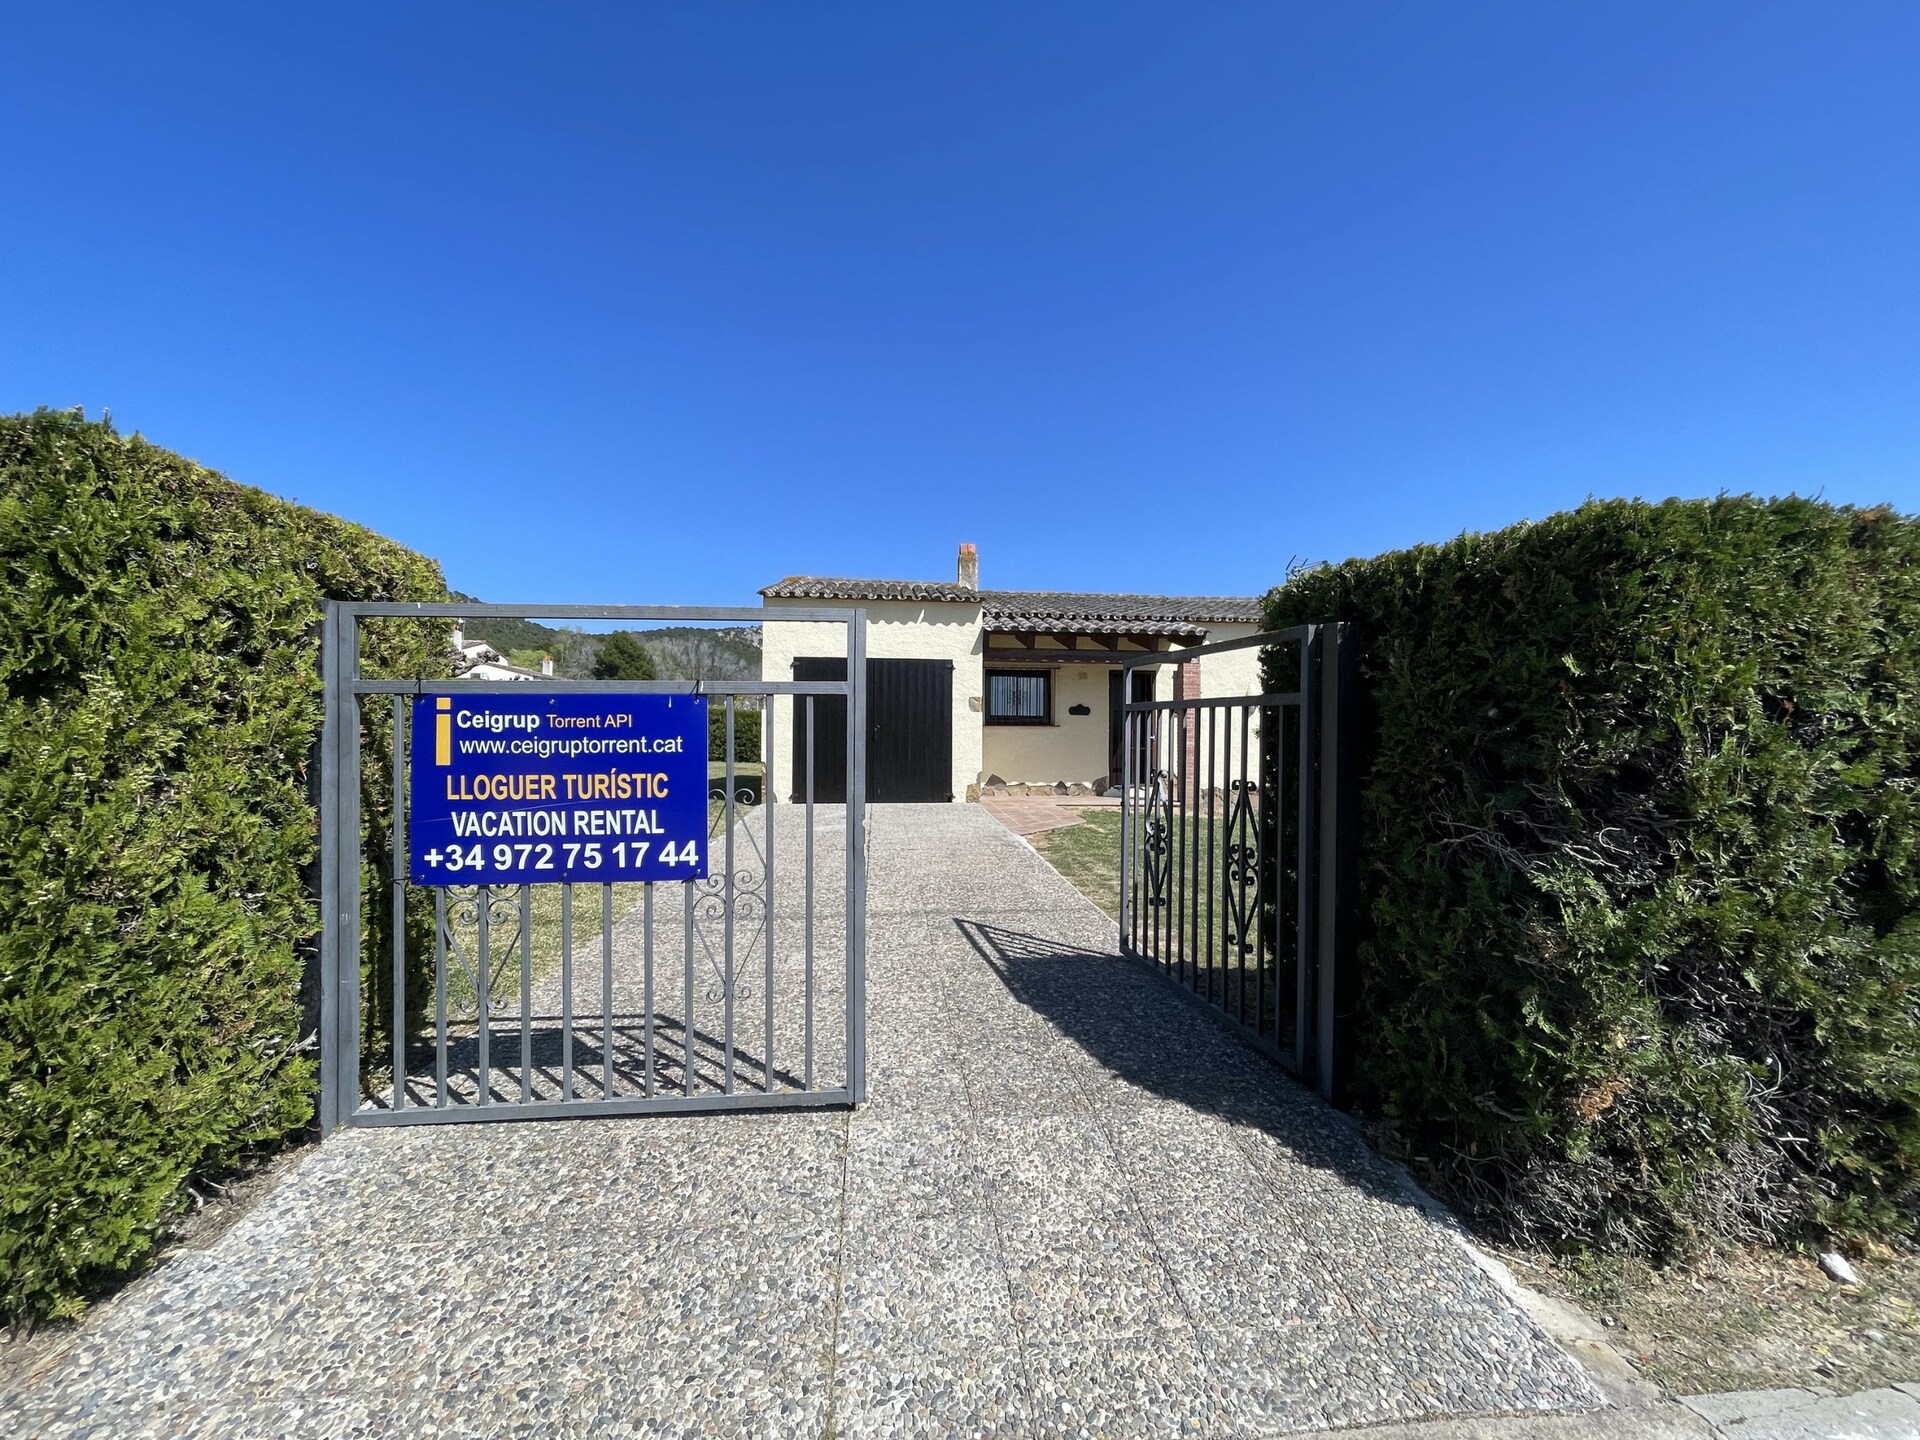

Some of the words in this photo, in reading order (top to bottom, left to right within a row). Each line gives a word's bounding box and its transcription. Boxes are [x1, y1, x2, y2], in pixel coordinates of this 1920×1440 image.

[457, 710, 540, 732] Ceigrup
[547, 715, 600, 728] Torrent
[604, 715, 632, 728] API
[459, 736, 682, 758] www.ceigruptorrent.cat
[447, 774, 557, 800] LLOGUER
[563, 768, 668, 799] TURÍSTIC
[451, 811, 565, 837] VACATION
[574, 810, 664, 835] RENTAL
[424, 844, 485, 871] +34
[494, 844, 553, 869] 972
[563, 843, 602, 868] 75
[612, 842, 650, 867] 17
[658, 840, 699, 866] 44
